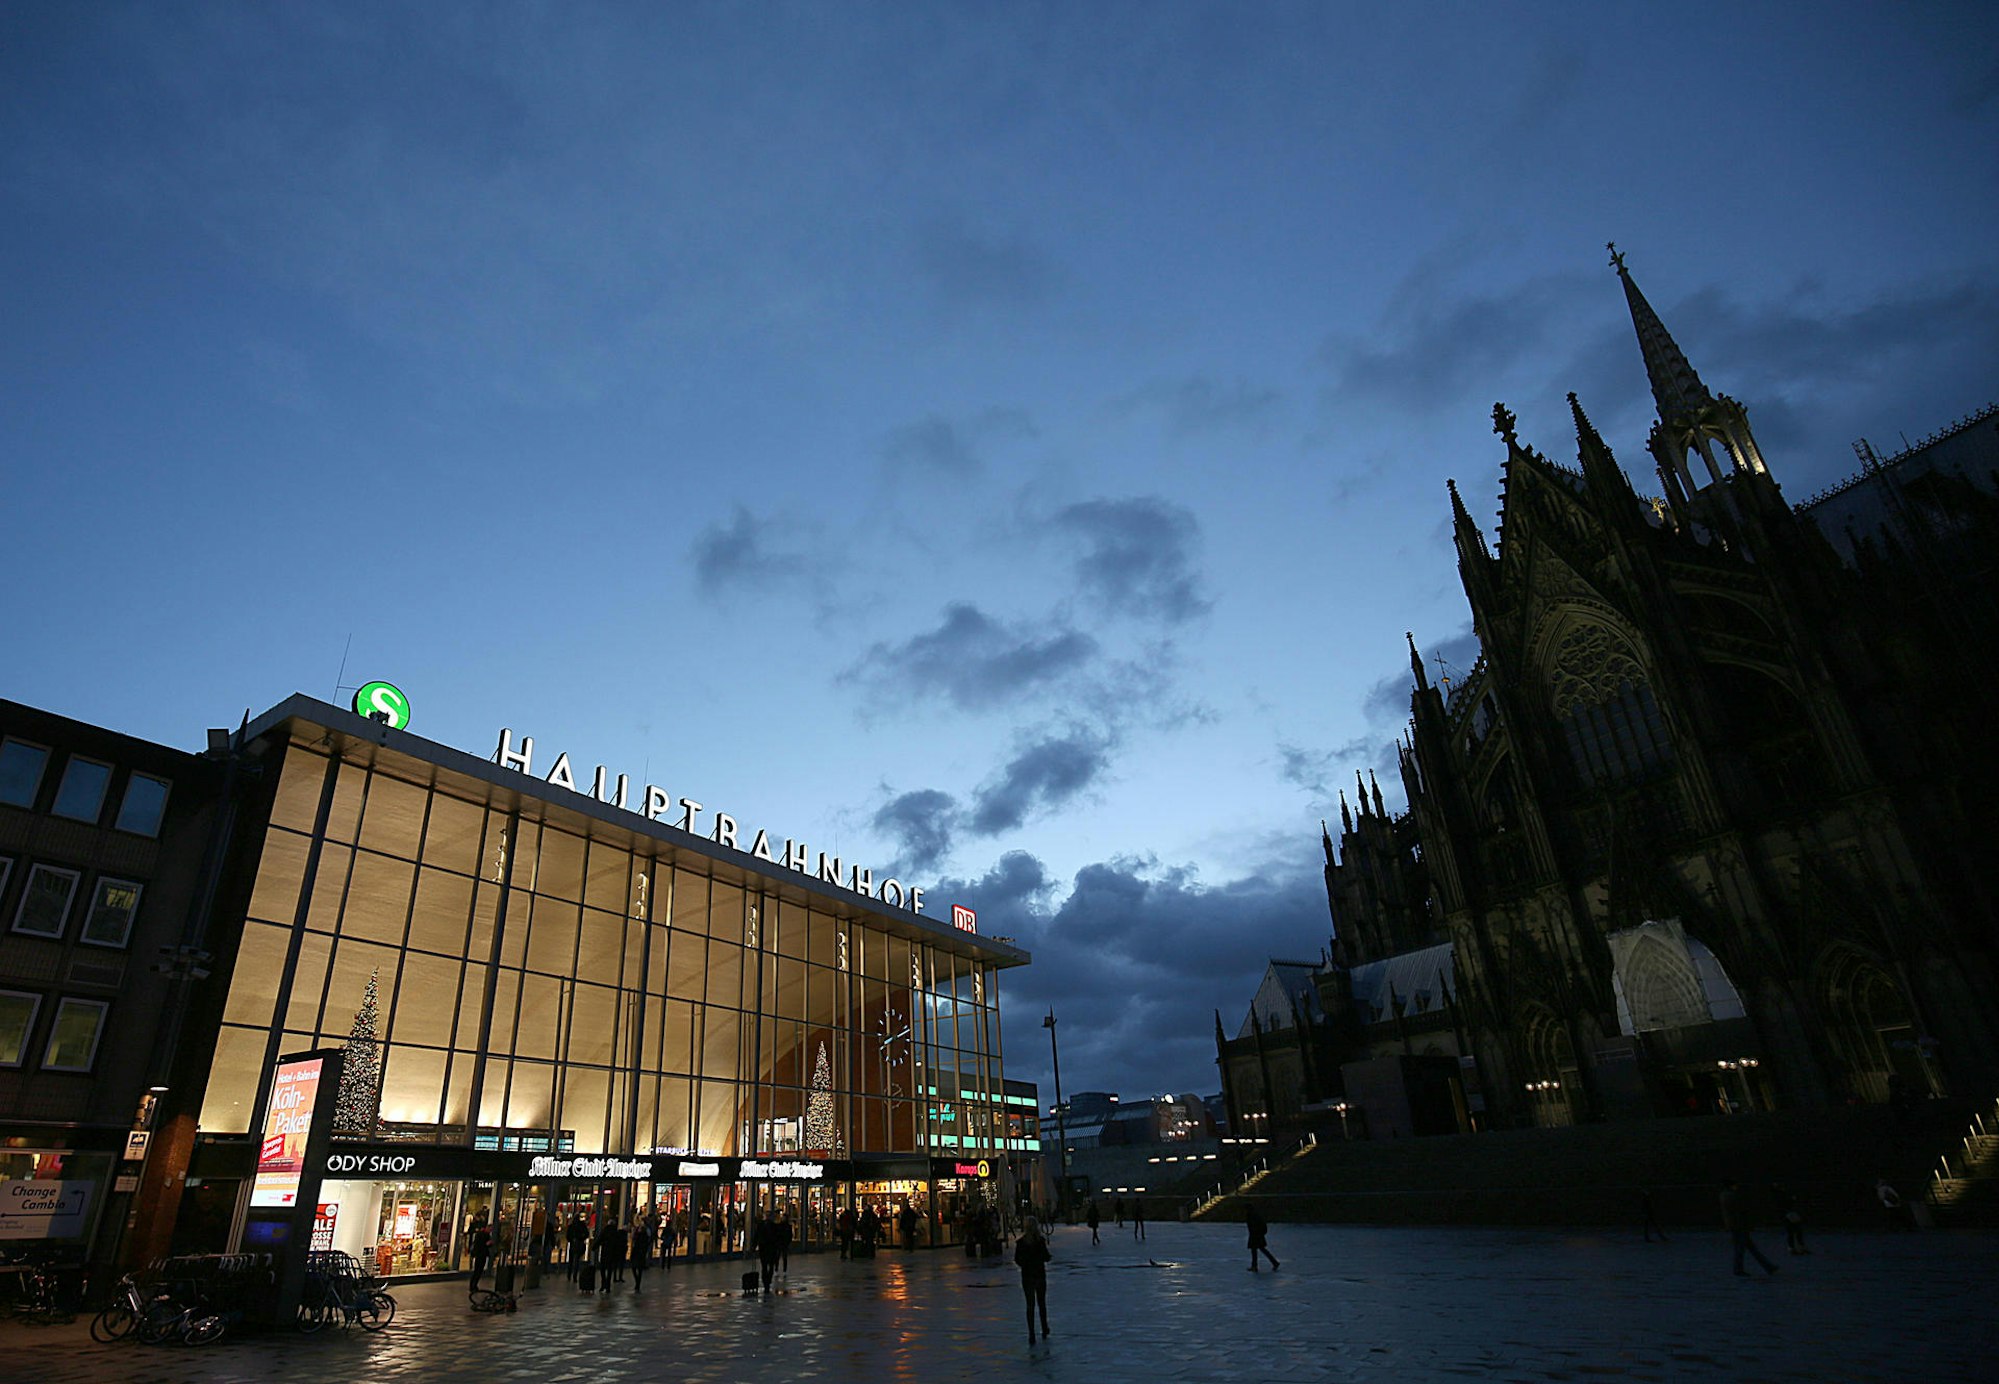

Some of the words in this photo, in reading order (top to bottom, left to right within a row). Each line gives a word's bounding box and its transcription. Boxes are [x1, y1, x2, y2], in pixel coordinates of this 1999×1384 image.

[496, 727, 924, 915] HAUPTBAHNHOF
[956, 910, 975, 933] DB
[273, 1084, 305, 1110] Köln-
[274, 1109, 312, 1135] Paket
[369, 1155, 416, 1173] SHOP
[955, 1162, 977, 1176] Kamps
[12, 1185, 57, 1199] Change
[21, 1199, 66, 1210] Cambio
[312, 1231, 332, 1240] OSSE
